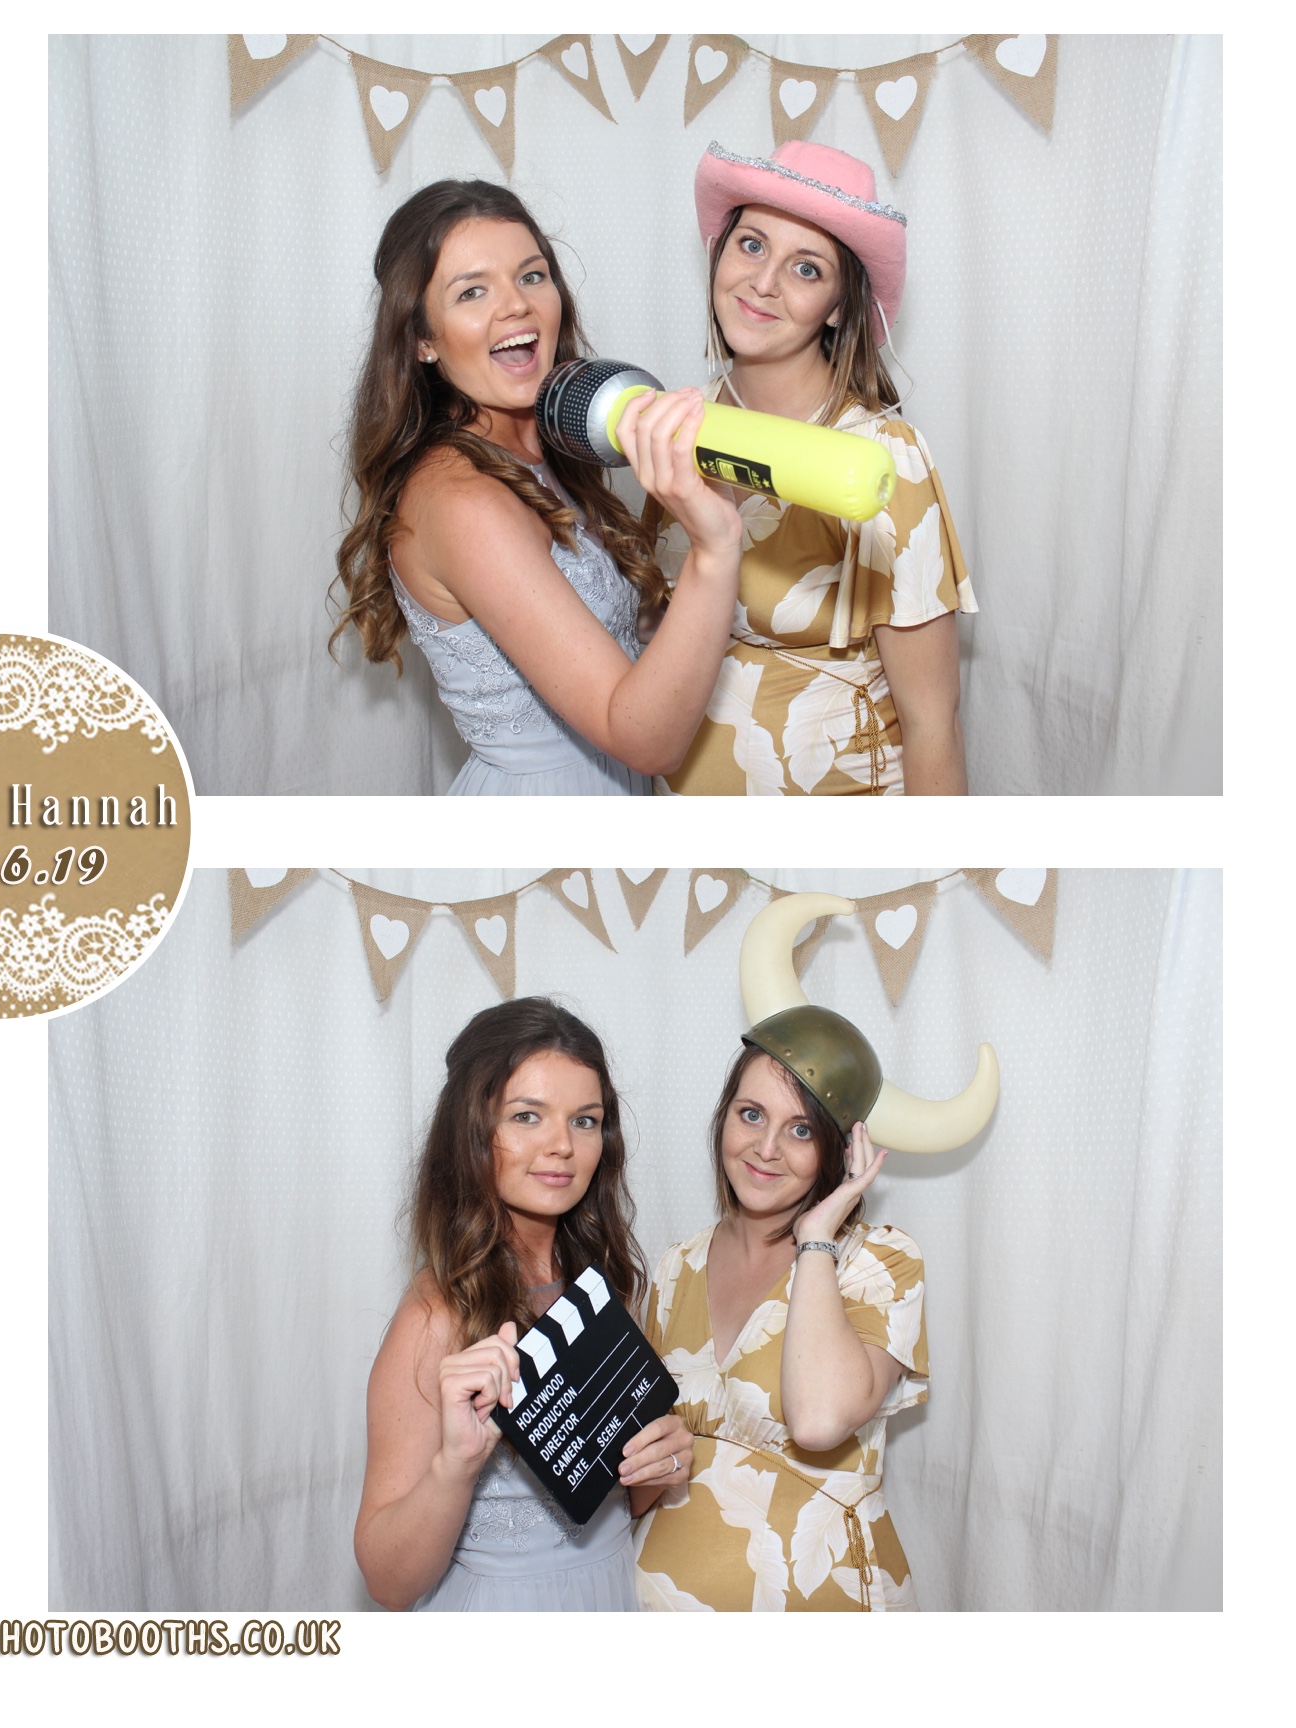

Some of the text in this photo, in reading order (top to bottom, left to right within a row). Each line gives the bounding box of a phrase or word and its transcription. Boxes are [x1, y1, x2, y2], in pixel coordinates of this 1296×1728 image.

[516, 1373, 565, 1431] HOLLYWOOD
[528, 1386, 578, 1447] PRODUCTION
[540, 1413, 580, 1462] DIRECTOR
[552, 1436, 586, 1477] CAMERA
[567, 1377, 651, 1487] DATE SCENE TAKE
